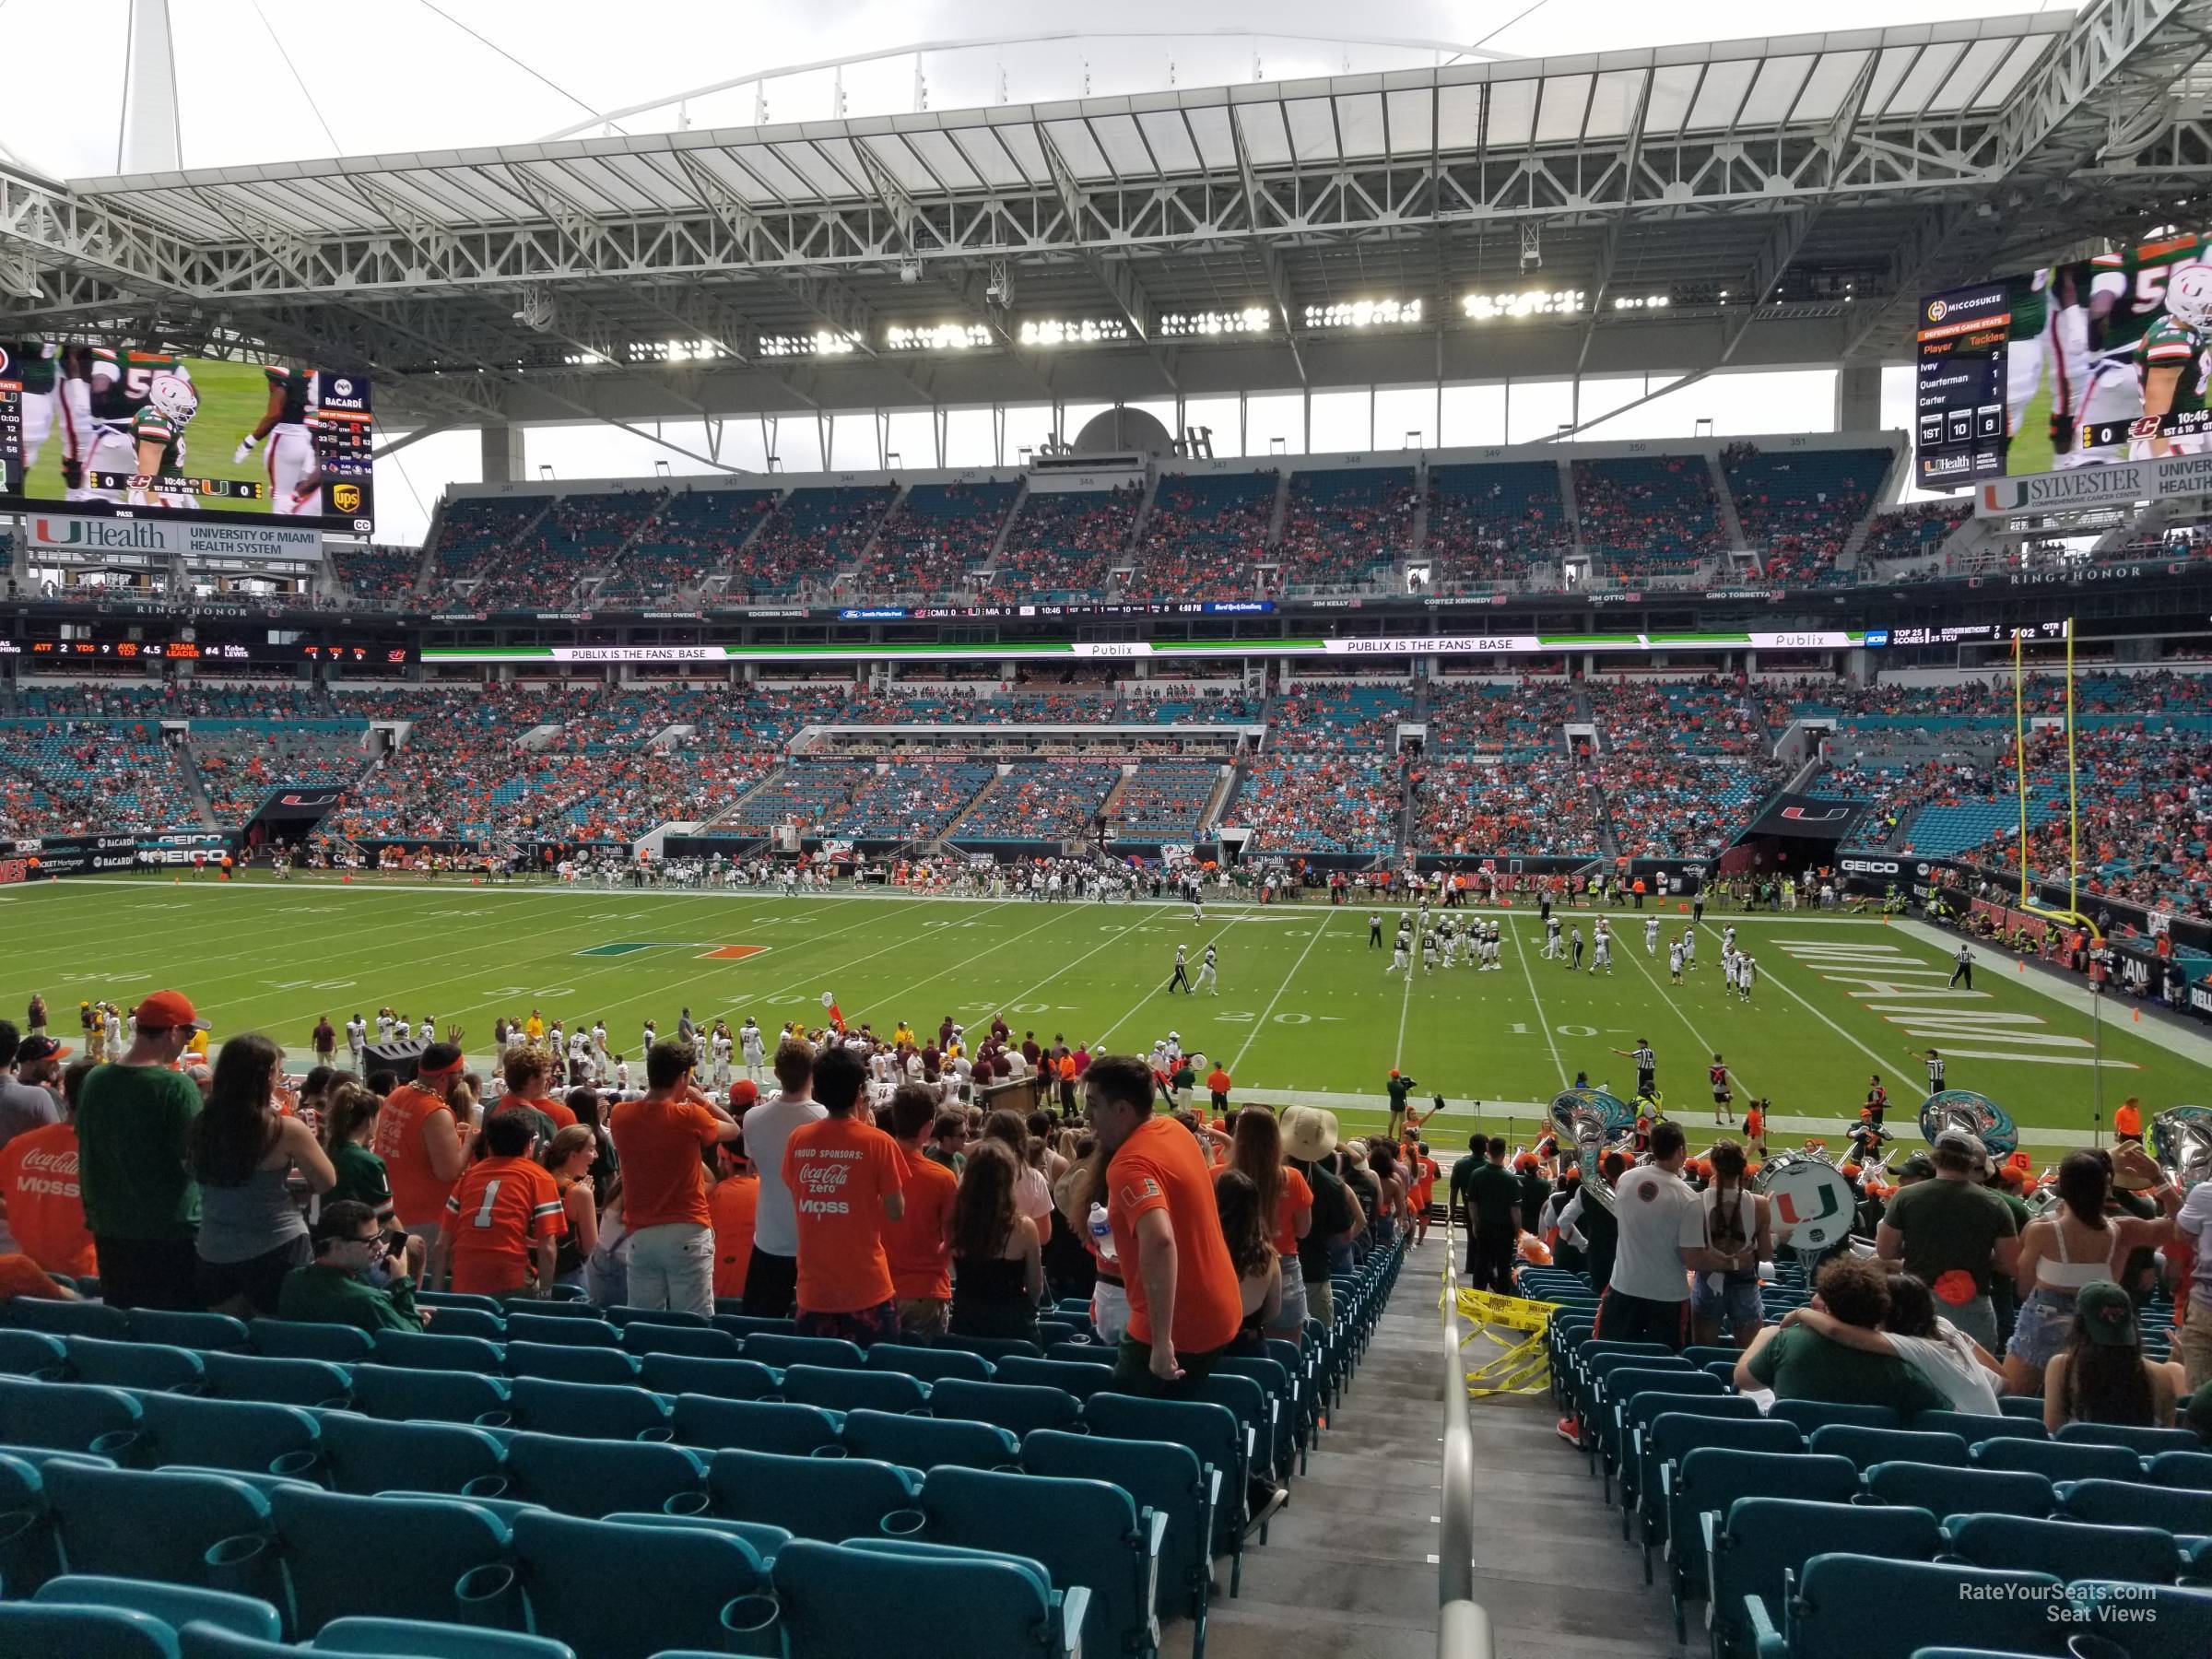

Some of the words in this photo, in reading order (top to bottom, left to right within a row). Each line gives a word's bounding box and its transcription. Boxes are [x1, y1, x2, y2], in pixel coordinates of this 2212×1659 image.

[1948, 294, 2001, 312] MICCOSUKEE
[1961, 322, 1981, 331] GAME
[1982, 317, 2003, 327] STATS
[1924, 342, 1953, 354] Player
[1970, 333, 2006, 346] Tackles
[1921, 362, 1938, 372] Ivey
[1992, 351, 1999, 360] 2
[1920, 375, 1969, 390] Quarterman
[1993, 370, 1997, 378] 1
[325, 397, 362, 408] BACARDÍ
[1920, 395, 1946, 406] Carter
[1993, 387, 1997, 395] 1
[1923, 428, 1940, 440] 1ST
[1953, 423, 1966, 435] 10
[1985, 419, 1994, 430] 8
[2101, 429, 2112, 441] 0
[2178, 410, 2209, 424] 10:46
[2163, 428, 2176, 436] 1ST
[2185, 425, 2194, 433] 10
[1484, 450, 1500, 458] 349
[1630, 443, 1646, 453] 350
[105, 477, 114, 487] 0
[164, 477, 186, 486] 10:46
[240, 486, 249, 496] 0
[1079, 477, 1094, 486] 346
[2031, 468, 2140, 500] SYLVESTER
[335, 492, 358, 508] ups
[2031, 496, 2086, 507] COMPREHENSIVE
[2087, 493, 2114, 502] CANCER
[2116, 490, 2142, 499] CENTER
[356, 521, 370, 530] CC
[190, 527, 257, 541] UNIVERSITY
[259, 530, 275, 541] OF
[277, 532, 314, 545] MIAMI
[190, 540, 235, 553] HEALTH
[237, 542, 281, 555] SYSTEM
[2011, 573, 2055, 585] RING
[2074, 567, 2141, 581] HONOR
[137, 606, 177, 615] RING
[192, 607, 247, 617] HONOR
[1041, 606, 1061, 615] 10:46
[1193, 604, 1202, 612] PM
[2042, 622, 2059, 630] QTR
[1347, 641, 1391, 652] PUBLIX
[1395, 641, 1406, 651] IS
[1411, 641, 1434, 651] THE
[1480, 640, 1512, 650] BASE
[1775, 635, 1825, 646] Publix
[1893, 636, 1924, 644] SCORES
[60, 644, 67, 653] 2
[76, 644, 95, 653] YDS
[102, 644, 110, 653] 9
[206, 647, 219, 655] #4
[571, 650, 607, 659] PUBLIX
[611, 650, 620, 659] IS
[624, 650, 643, 658] THE
[678, 649, 706, 658] BASE
[1092, 645, 1133, 655] Publix
[908, 755, 934, 763] CANES
[935, 755, 968, 763] SOCIETY
[107, 835, 135, 847] BACARDÍ
[158, 834, 223, 845] GEICO
[57, 857, 85, 867] Mortgage
[147, 849, 229, 864] GEICO
[1841, 859, 1899, 874] GEICO
[958, 1001, 1050, 1014] 30
[1213, 1011, 1312, 1024] 20
[1504, 1022, 1599, 1038] 10
[794, 1148, 817, 1159] PROUD
[819, 1149, 864, 1159] SPONSORS:
[2016, 1155, 2027, 1170] G
[799, 1162, 851, 1185] Coca-Cola
[809, 1183, 836, 1194] zero
[473, 1180, 501, 1228] 1
